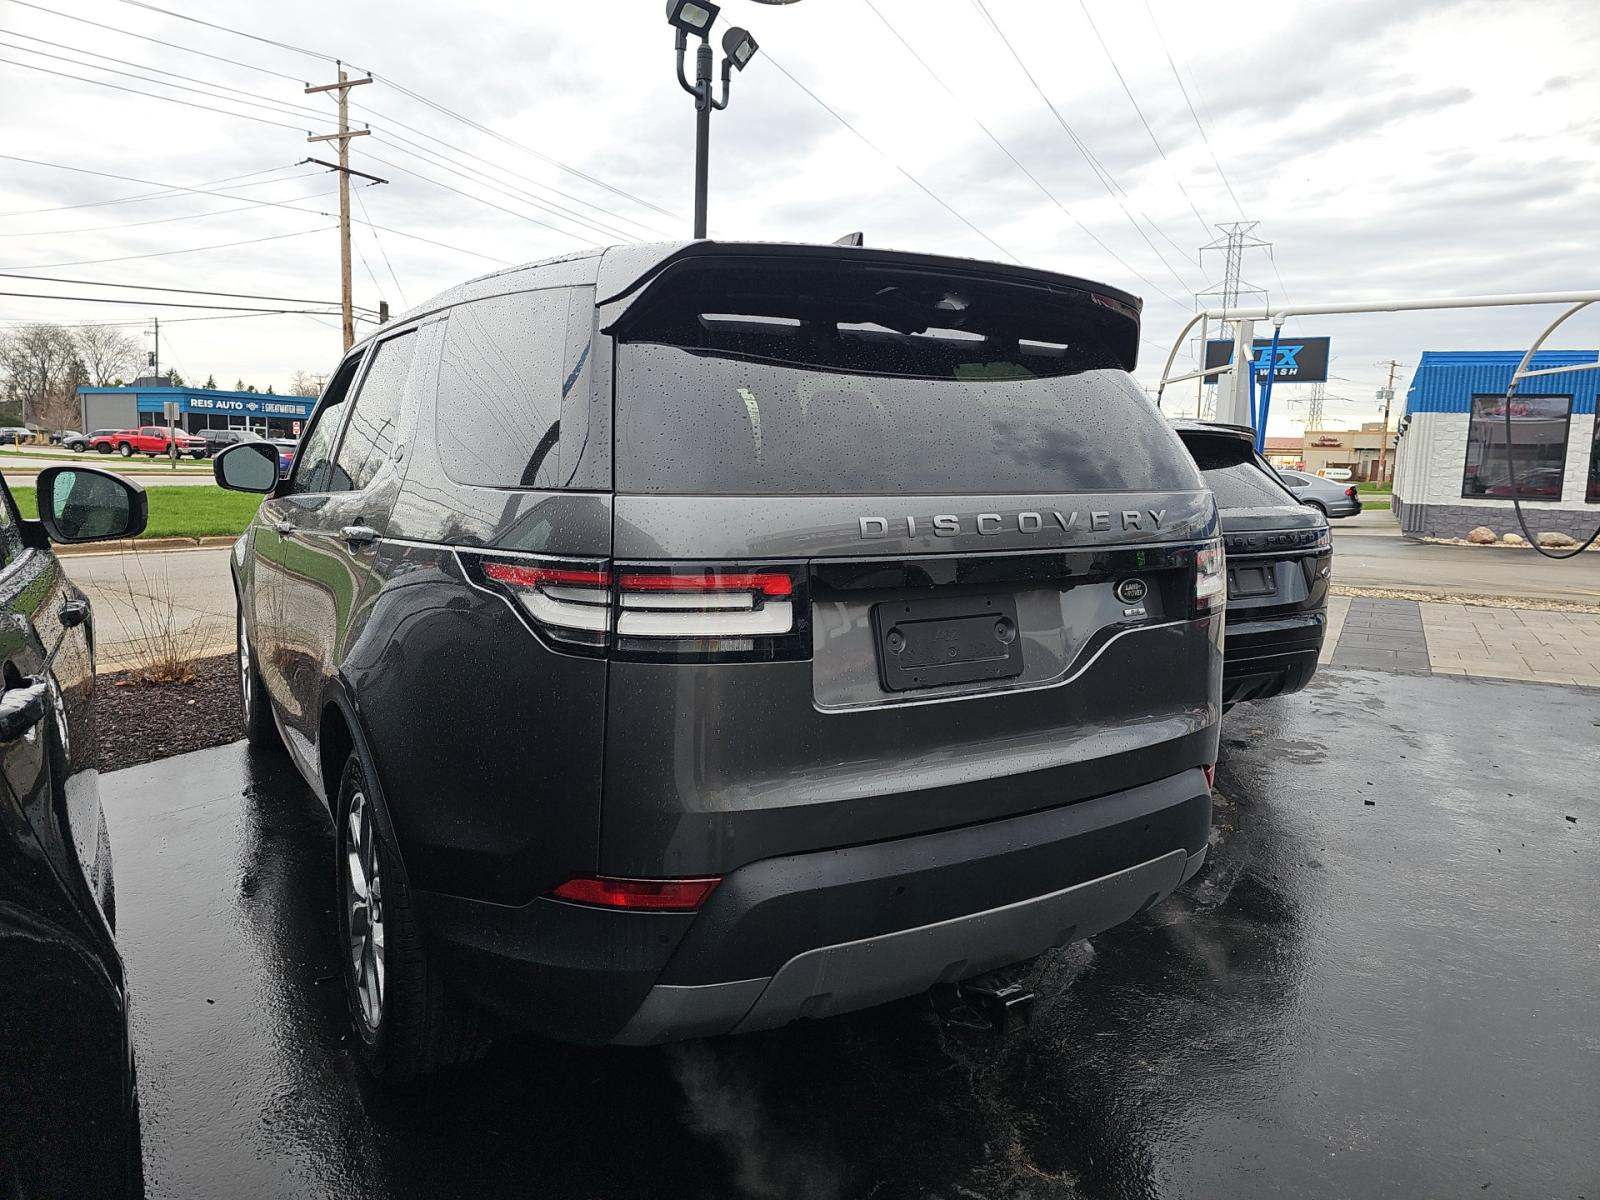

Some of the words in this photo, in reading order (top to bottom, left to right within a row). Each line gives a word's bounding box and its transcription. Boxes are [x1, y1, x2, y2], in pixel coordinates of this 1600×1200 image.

[190, 398, 214, 408] REIS
[216, 400, 243, 410] AUTO
[859, 509, 1168, 539] DISCOVERY
